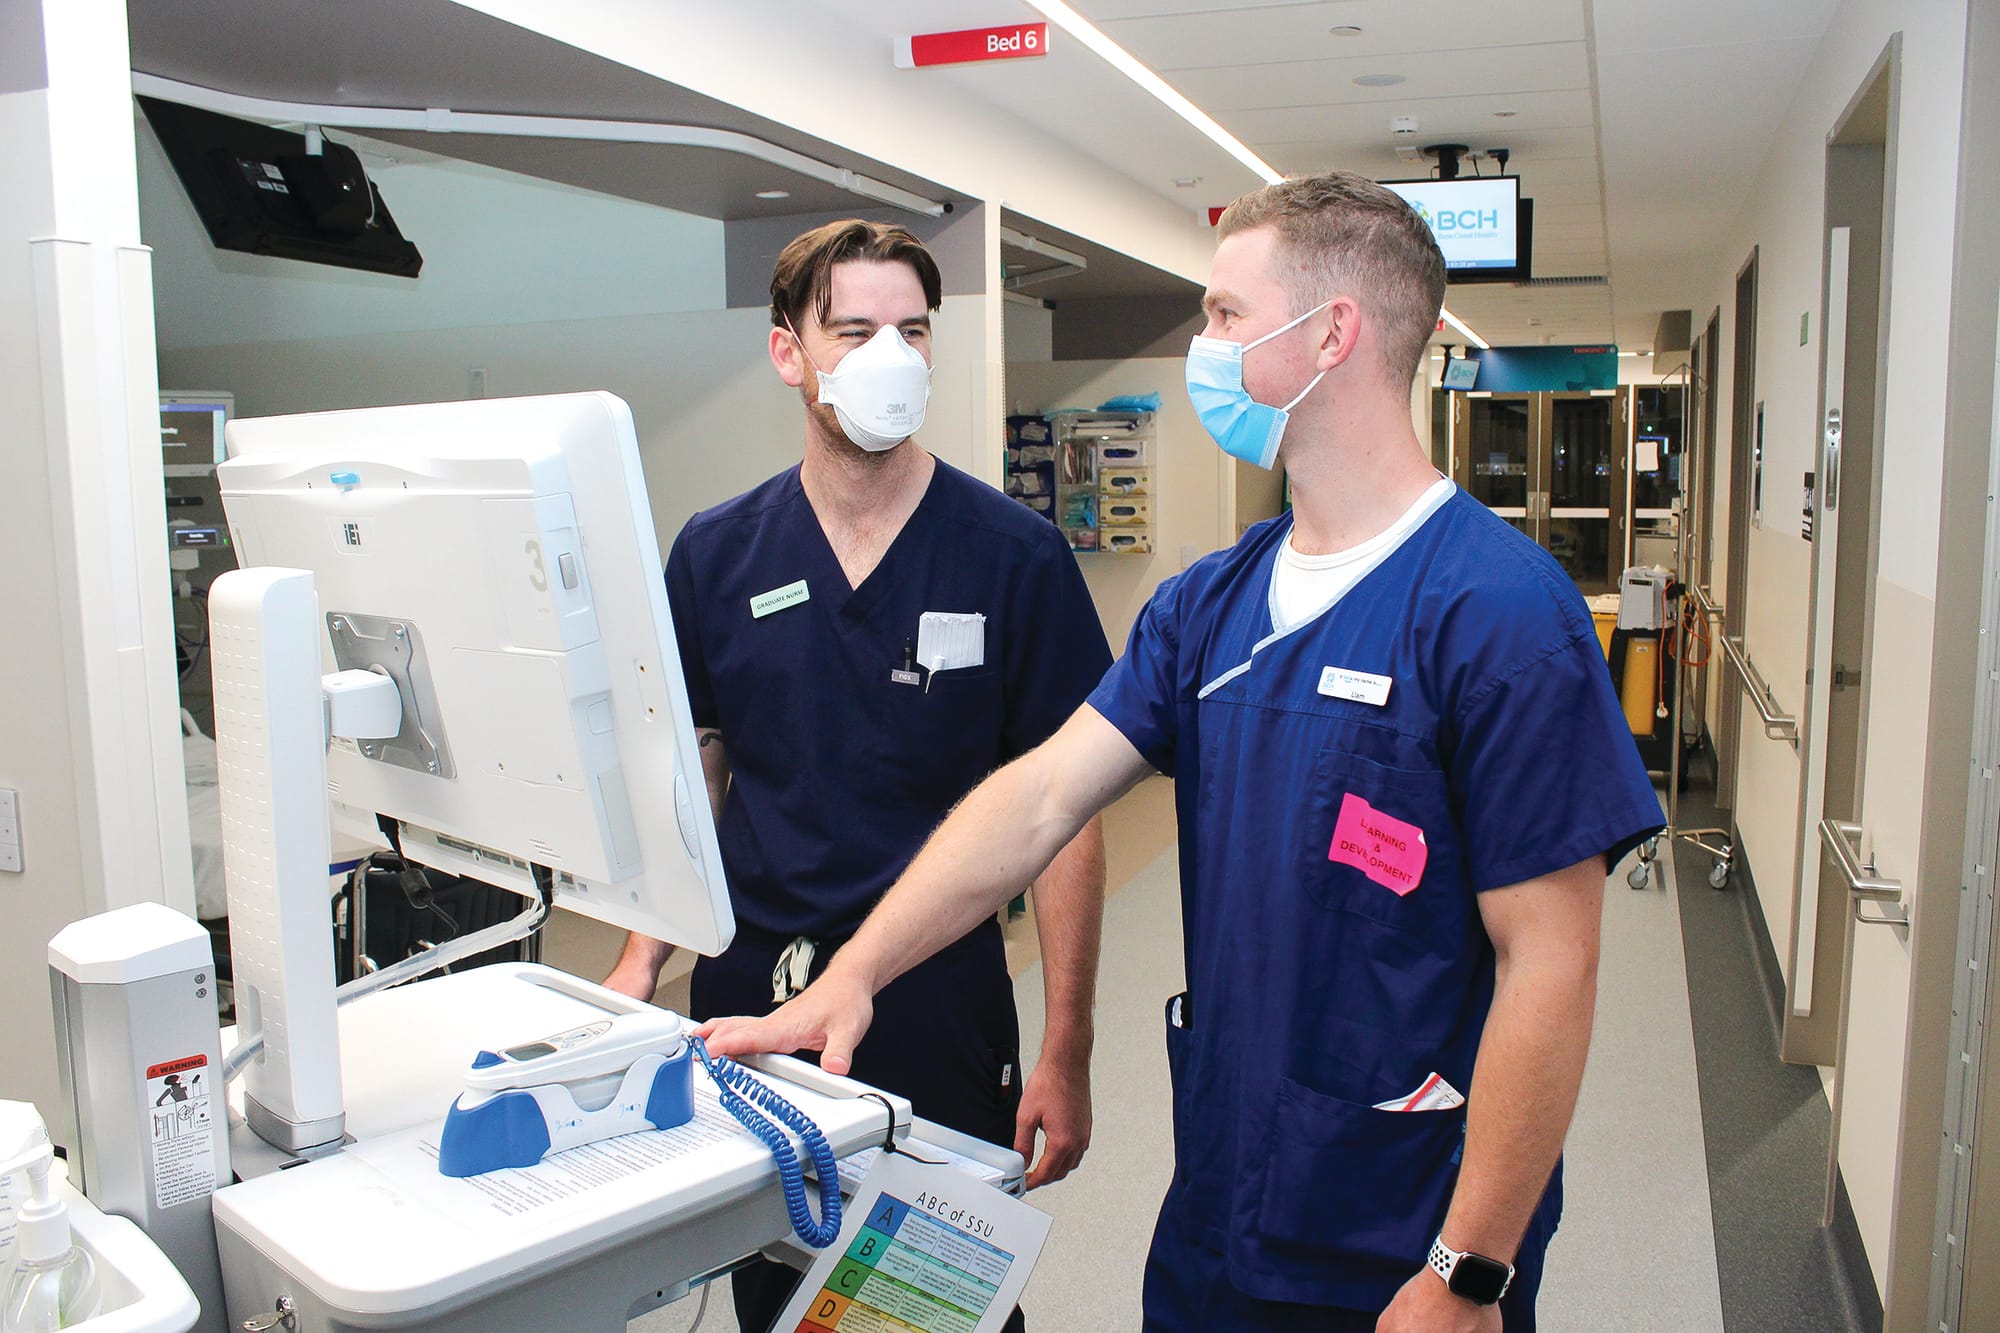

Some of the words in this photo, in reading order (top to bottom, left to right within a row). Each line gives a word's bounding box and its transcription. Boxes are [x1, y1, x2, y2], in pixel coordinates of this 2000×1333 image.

[987, 31, 1020, 52] Bed
[1025, 31, 1037, 49] 6
[1437, 208, 1497, 230] BCH
[887, 403, 906, 414] 3M
[525, 540, 548, 592] 3
[757, 596, 784, 610] GRADUATE
[786, 589, 803, 600] NURSE
[1351, 691, 1365, 699] Liam
[1374, 844, 1380, 852] &
[160, 1059, 203, 1073] WARNING
[877, 1206, 893, 1227] A
[916, 1191, 949, 1215] ABC
[950, 1211, 965, 1223] of
[966, 1215, 994, 1238] SSU
[860, 1237, 876, 1257] B
[840, 1269, 858, 1288] C
[818, 1299, 836, 1318] D
